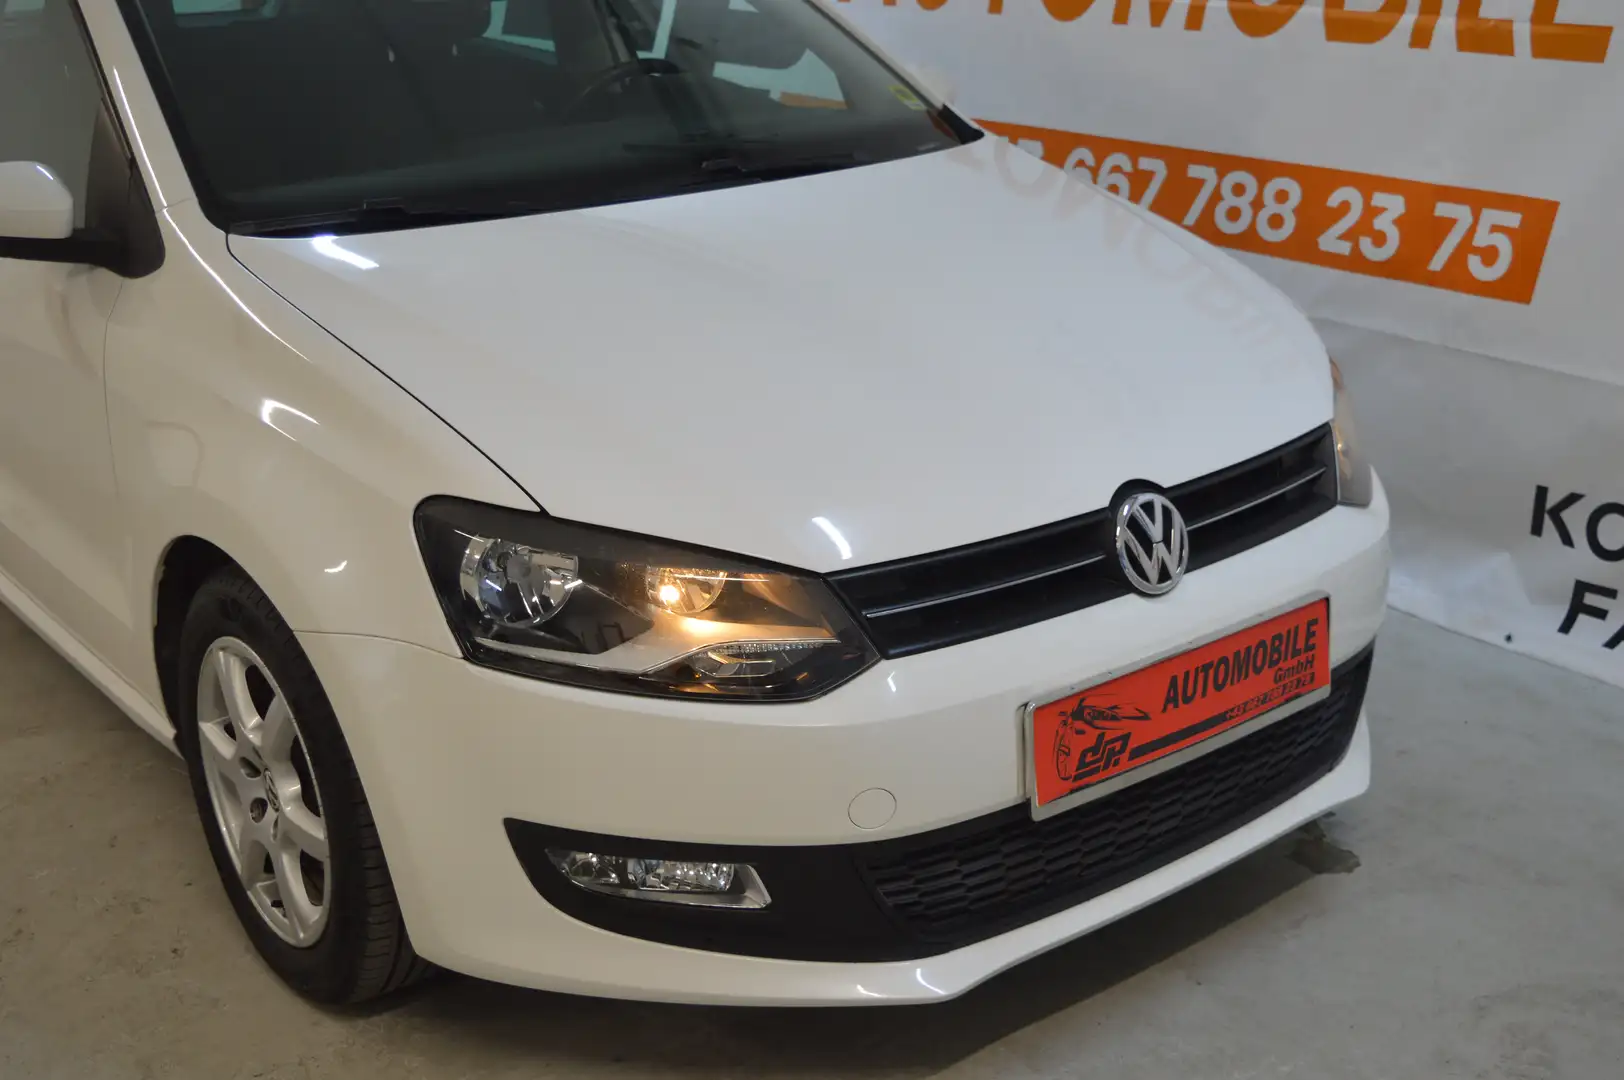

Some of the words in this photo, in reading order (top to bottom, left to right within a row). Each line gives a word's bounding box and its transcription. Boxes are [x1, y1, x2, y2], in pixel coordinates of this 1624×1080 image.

[1182, 164, 1302, 243] 788
[1317, 186, 1406, 262] 23
[1427, 202, 1523, 282] 75
[1161, 618, 1319, 714] AUTOMOBILE
[1273, 654, 1315, 685] GmbH
